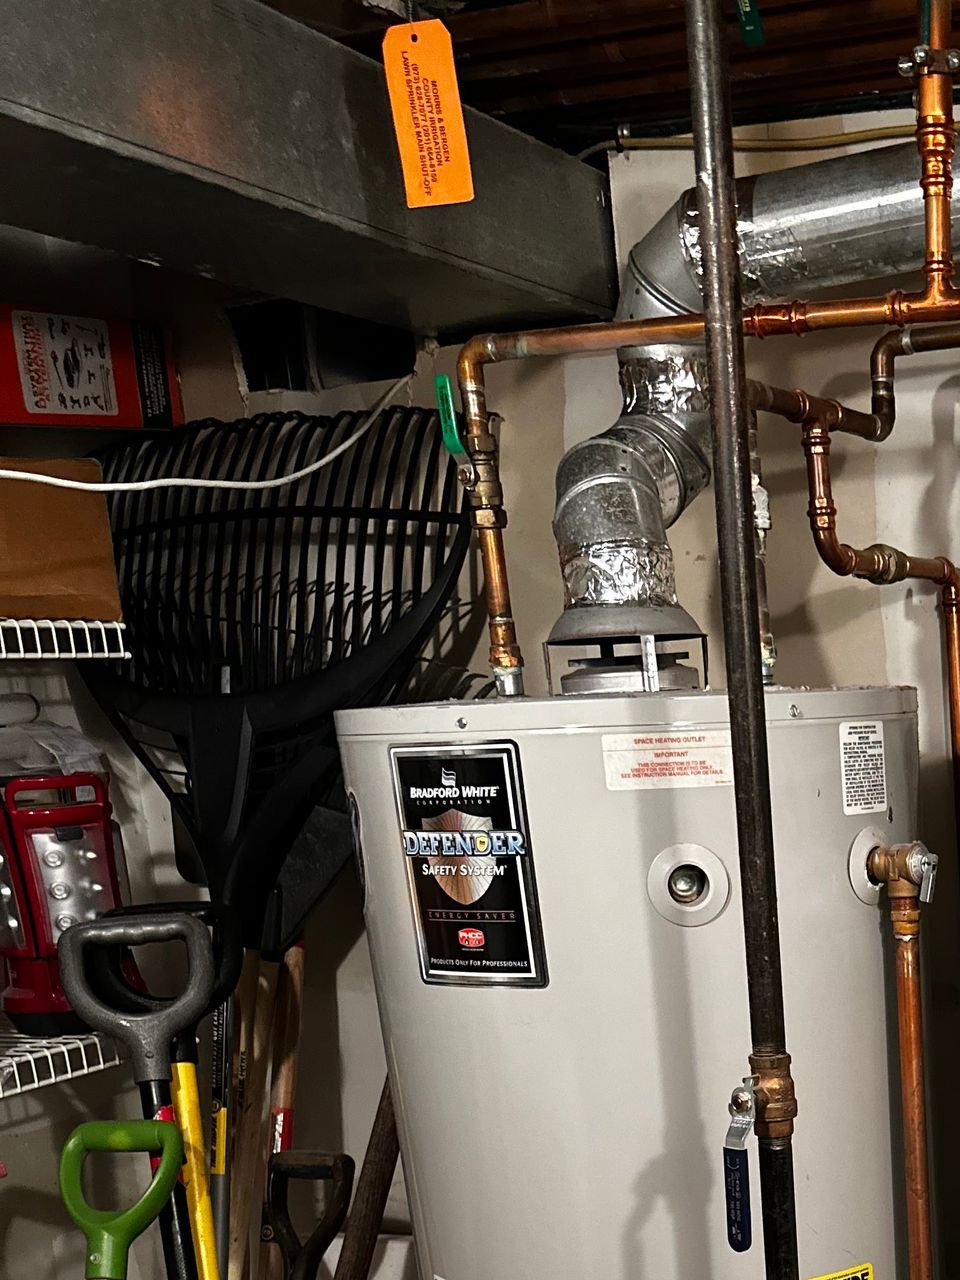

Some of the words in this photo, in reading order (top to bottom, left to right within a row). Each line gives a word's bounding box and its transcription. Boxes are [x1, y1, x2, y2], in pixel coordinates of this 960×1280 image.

[402, 51, 410, 77] LAWN
[406, 79, 419, 128] SPRINKLER
[415, 128, 423, 153] MAIN
[419, 153, 431, 196] SHUT-OFF
[423, 78, 434, 114] COUNTY
[429, 116, 442, 166] IRRIGATION
[431, 81, 442, 116] MORRIS
[439, 125, 449, 162] BERGEN
[410, 787, 459, 798] BRADFORD
[462, 786, 497, 797] WHITE
[404, 830, 525, 856] DEFENDER
[422, 864, 457, 876] SAFETY
[460, 864, 505, 876] SYSTEM
[429, 912, 469, 920] ENERGY
[477, 912, 516, 920] SAVER
